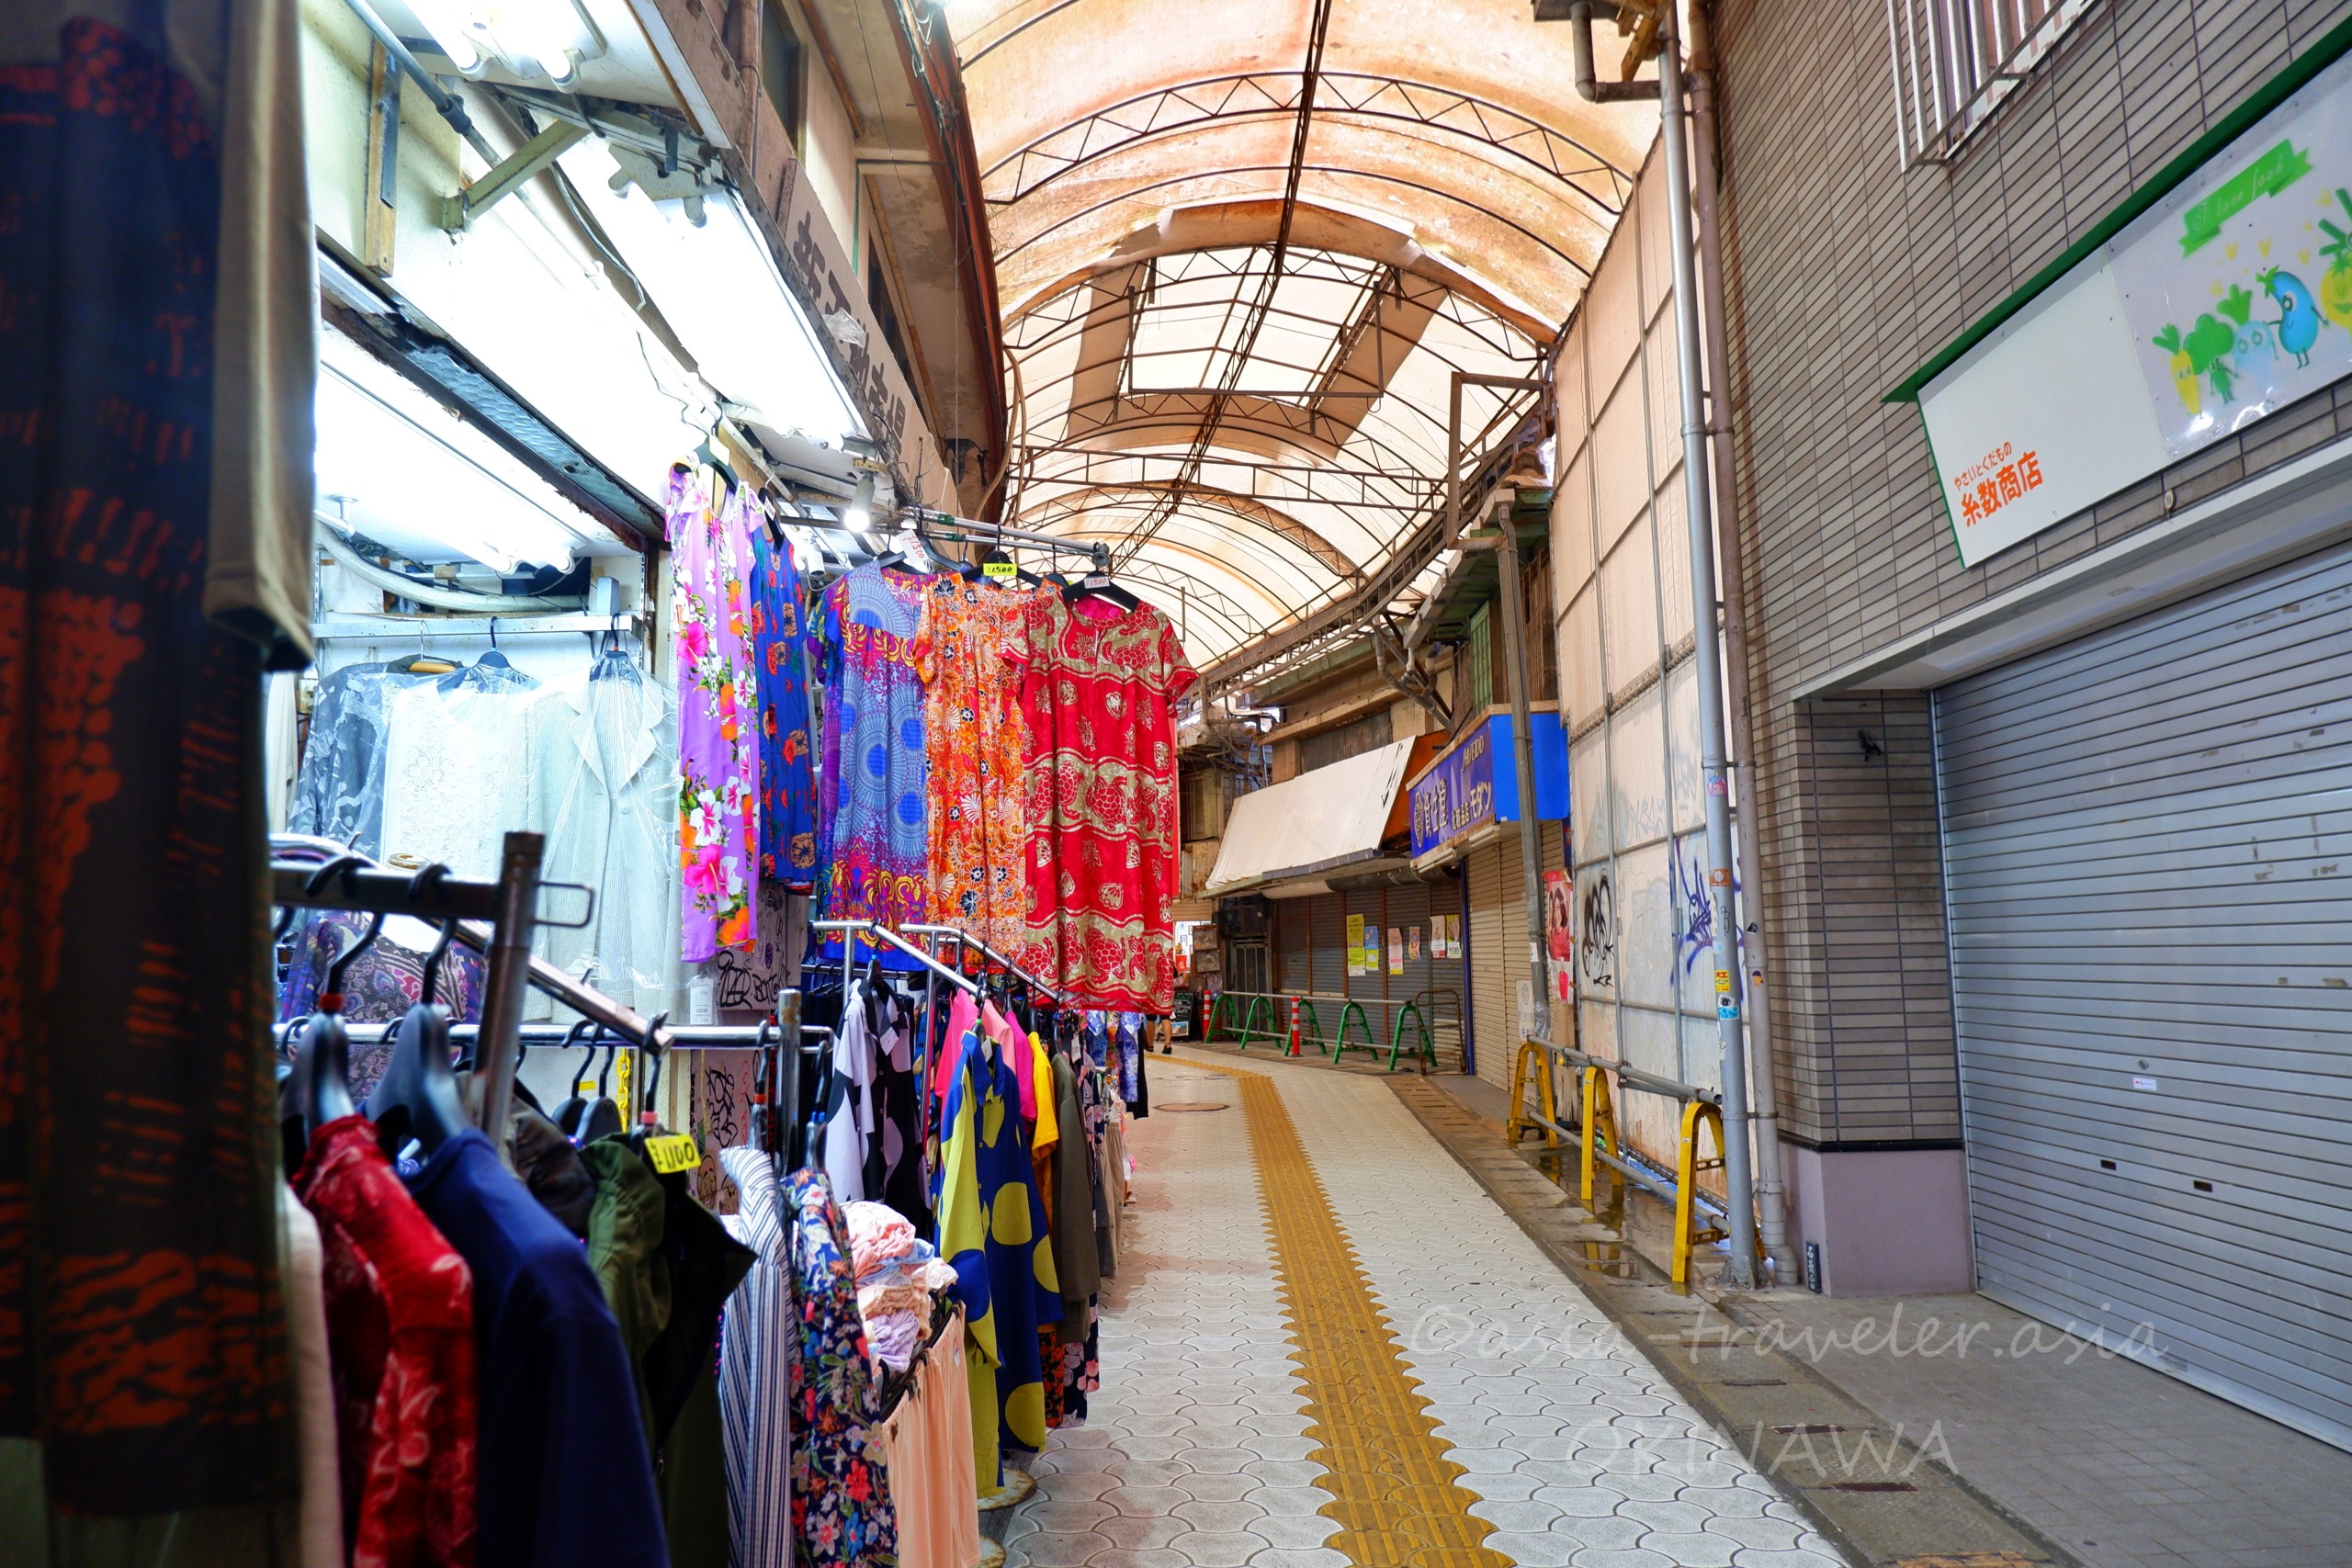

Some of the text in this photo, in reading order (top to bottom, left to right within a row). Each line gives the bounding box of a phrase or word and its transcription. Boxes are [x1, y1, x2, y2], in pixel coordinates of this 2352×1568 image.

[1953, 441, 2013, 491] やさいとくだもの
[1961, 450, 2043, 528] 糸数商店
[1461, 735, 1485, 772] SHISEIDO
[1422, 778, 1449, 838] 資生堂
[1469, 780, 1492, 819] モダン
